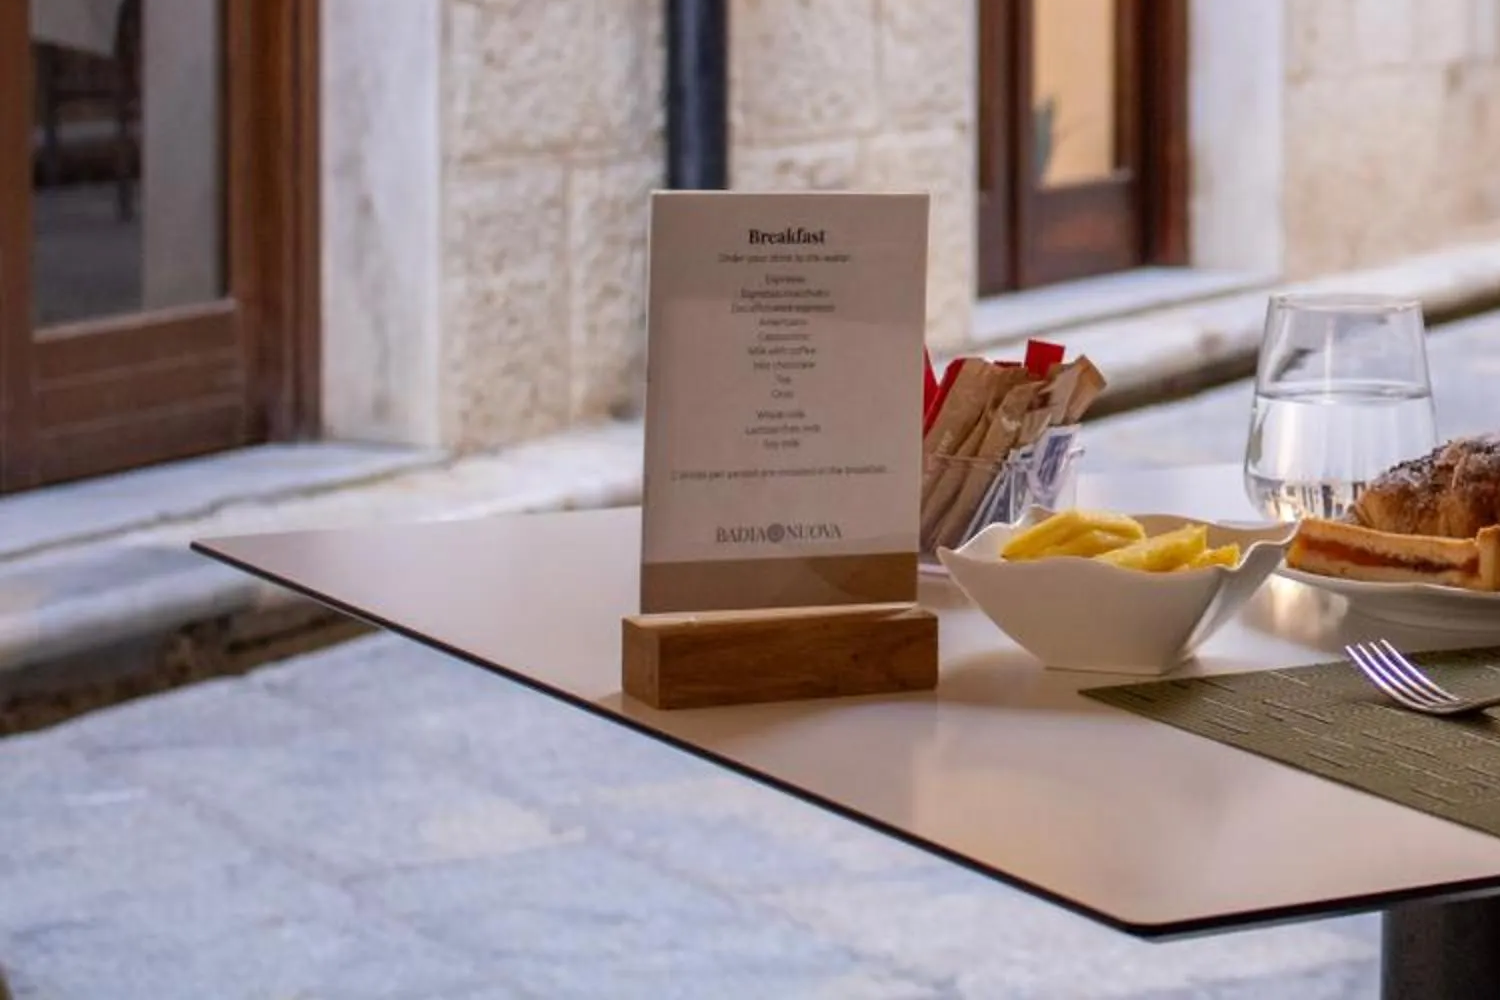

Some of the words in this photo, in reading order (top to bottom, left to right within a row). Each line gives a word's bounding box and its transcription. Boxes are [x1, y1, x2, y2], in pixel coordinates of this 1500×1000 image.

[749, 227, 826, 245] Breakfast
[716, 525, 767, 543] BADIA
[786, 522, 842, 541] NUOVA
